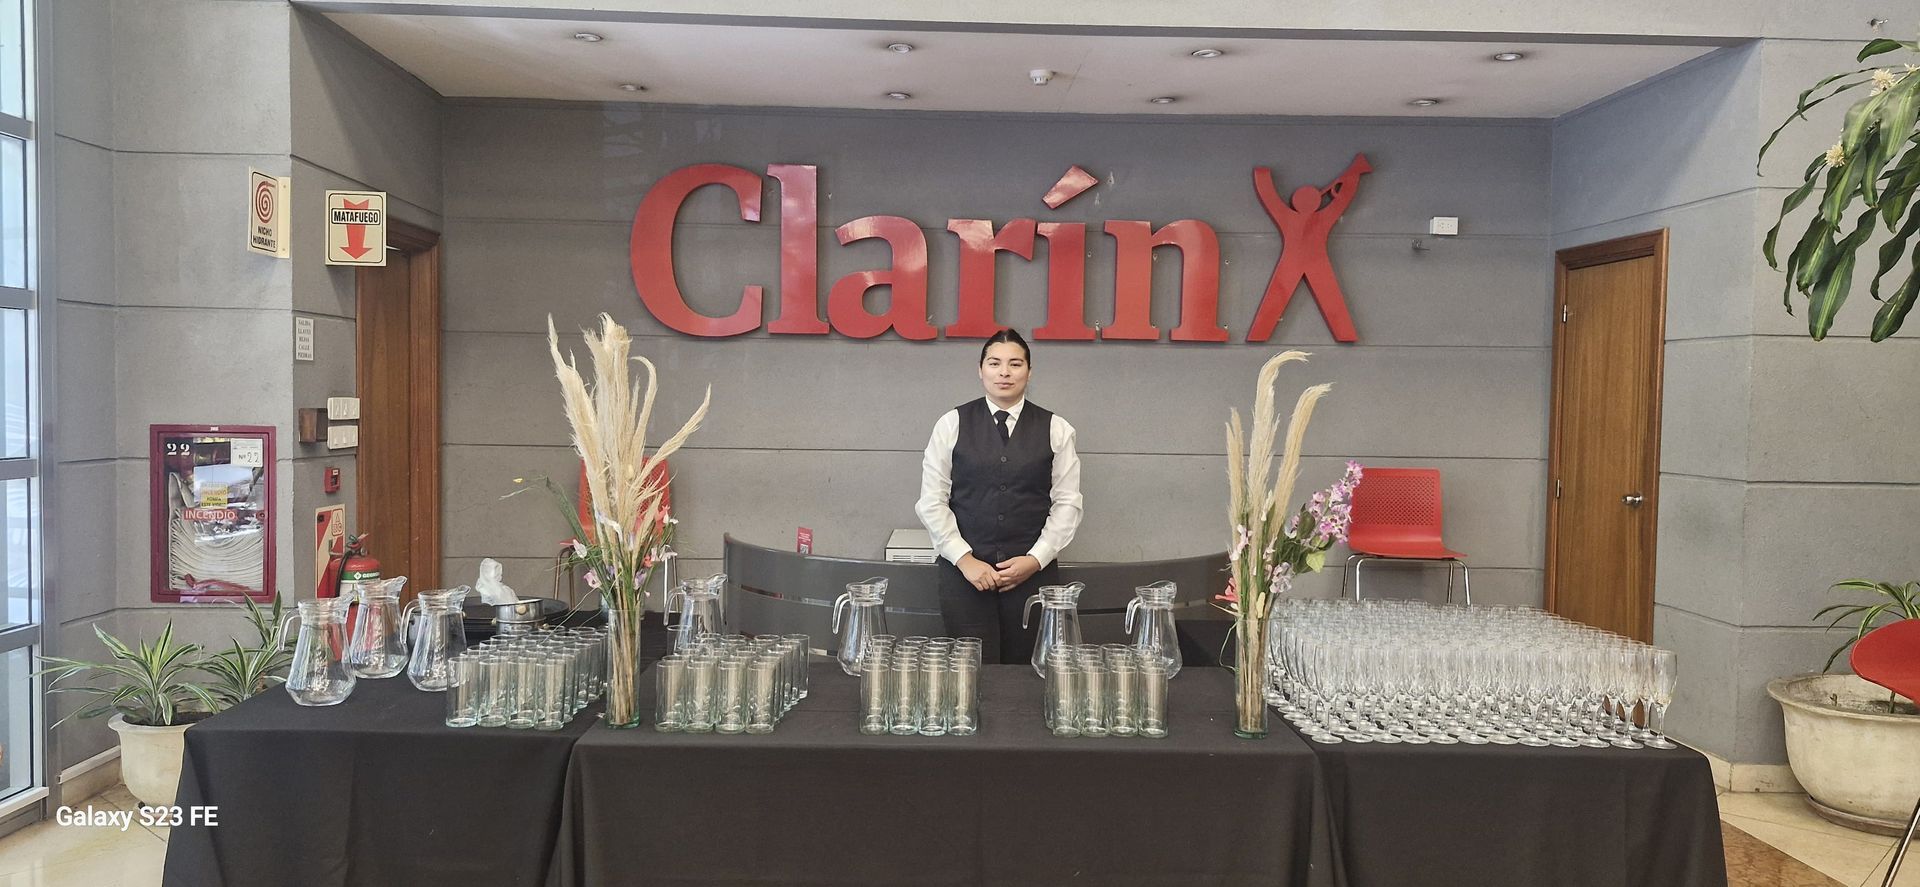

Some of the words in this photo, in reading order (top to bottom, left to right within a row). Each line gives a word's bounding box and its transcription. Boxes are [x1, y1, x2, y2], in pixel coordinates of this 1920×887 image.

[333, 211, 379, 223] MATAFUEGO
[258, 225, 272, 237] NICHO
[253, 235, 276, 249] HIDRANTE
[630, 163, 1229, 342] Clarín
[166, 443, 190, 456] 22
[247, 451, 260, 463] 22
[185, 510, 236, 520] INCENDIO
